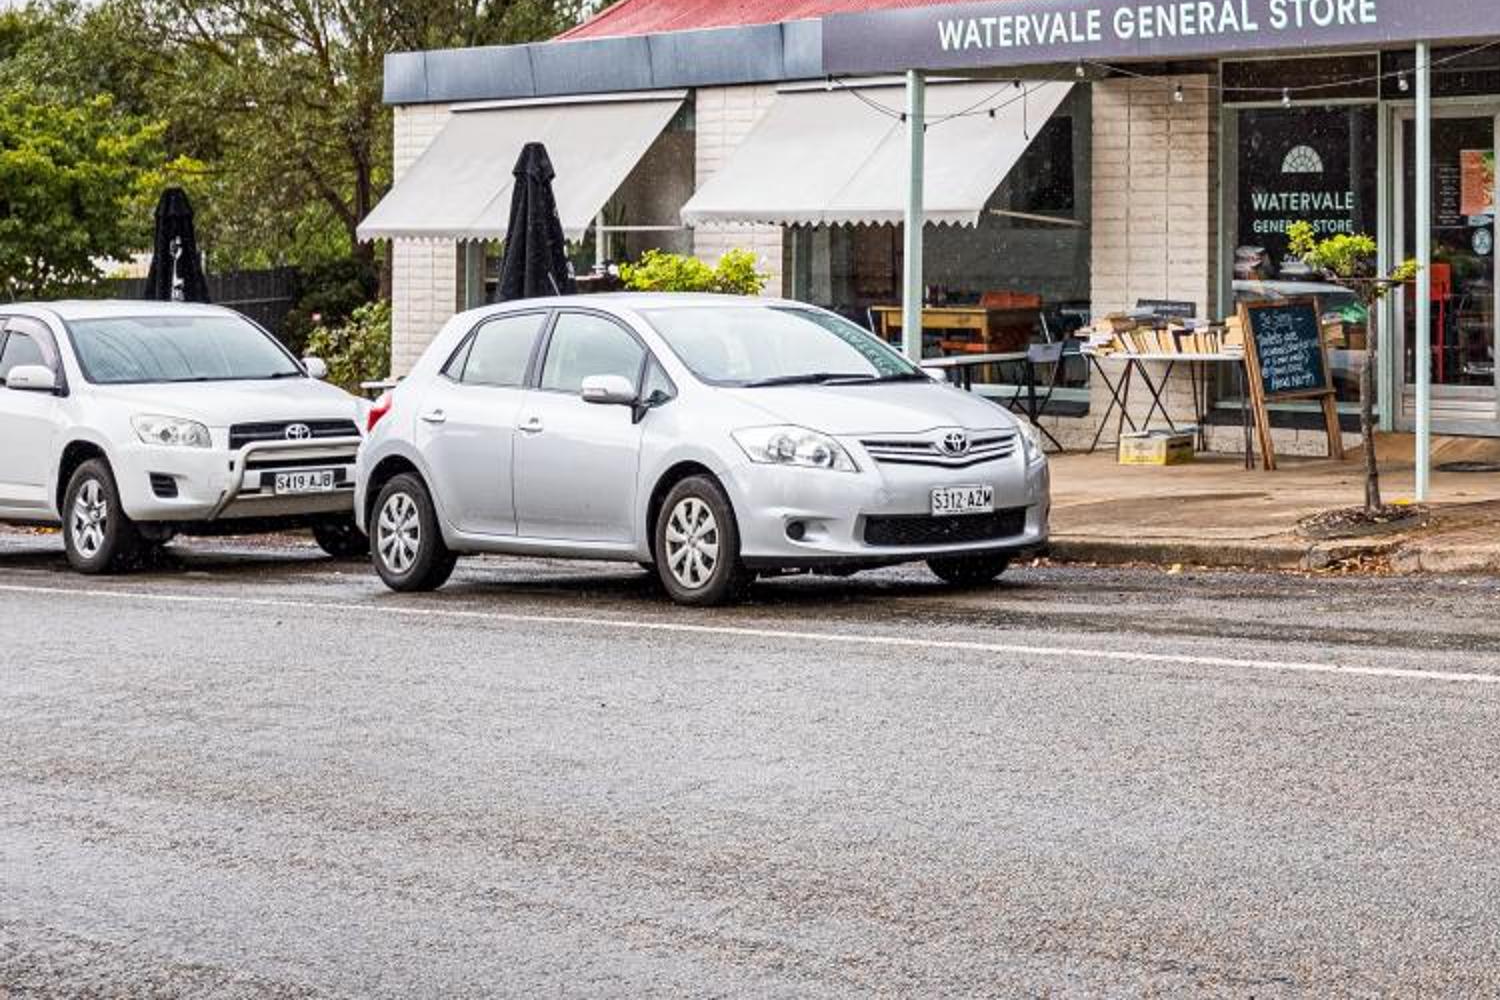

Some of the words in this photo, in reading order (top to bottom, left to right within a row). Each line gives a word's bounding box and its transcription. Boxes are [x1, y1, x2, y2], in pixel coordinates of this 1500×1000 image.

[938, 9, 1101, 51] WATERVALE
[1251, 191, 1354, 211] WATERVALE
[1312, 219, 1354, 233] STORE
